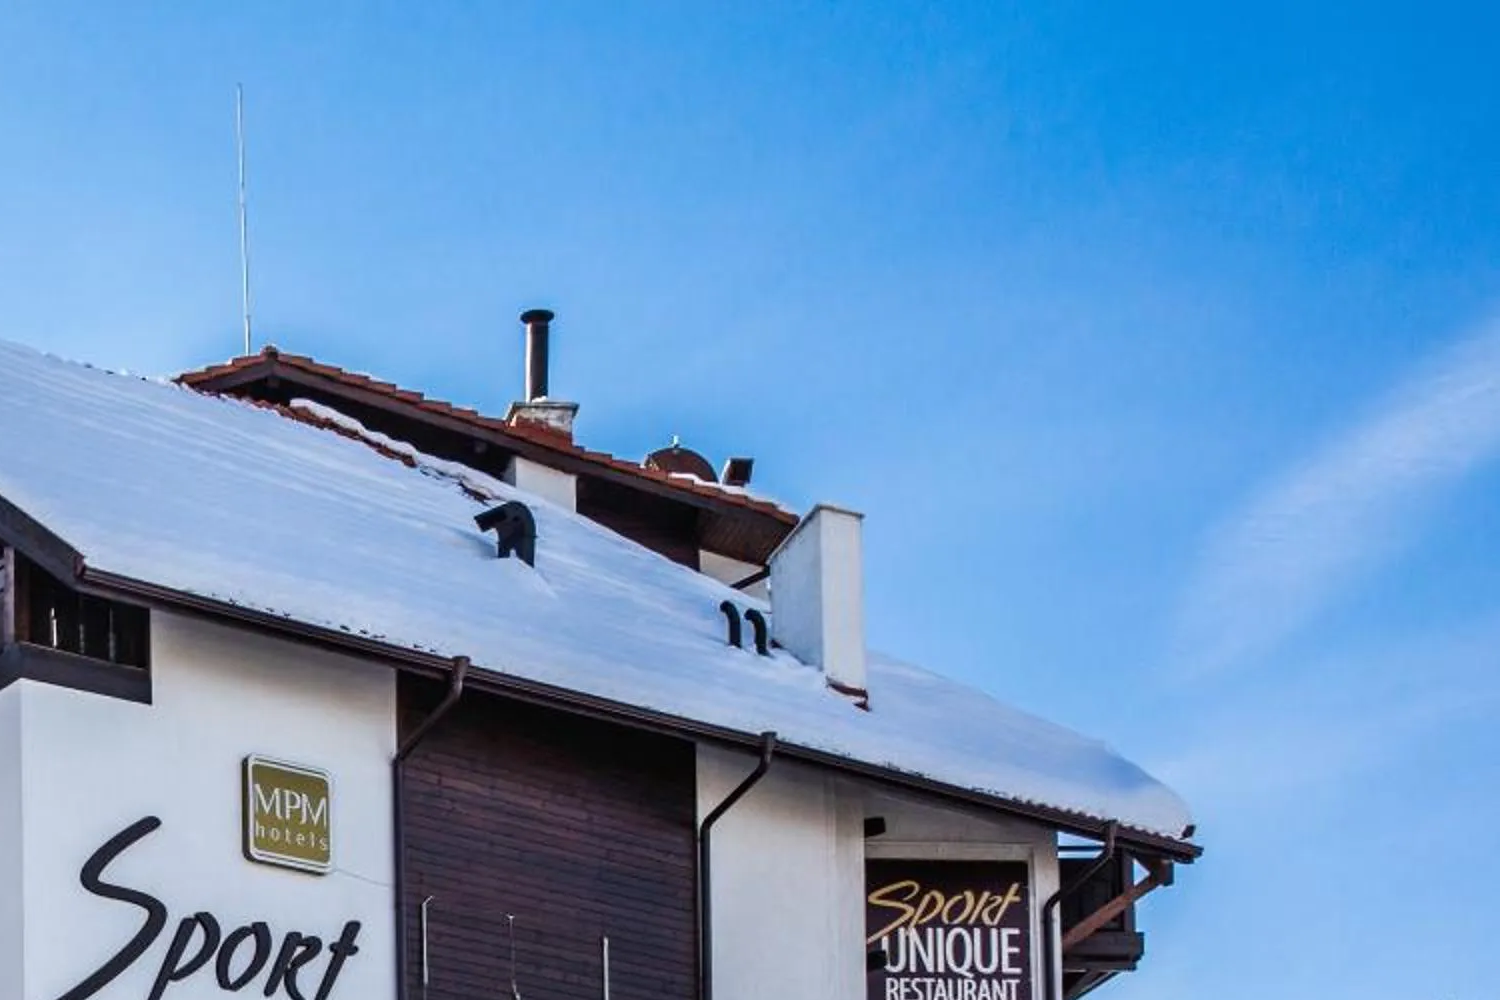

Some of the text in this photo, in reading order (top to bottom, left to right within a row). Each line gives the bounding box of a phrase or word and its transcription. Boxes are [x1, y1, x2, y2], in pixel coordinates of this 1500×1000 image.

[254, 783, 327, 828] MPM
[255, 820, 329, 851] hotels
[881, 927, 1023, 977] UNIQUE
